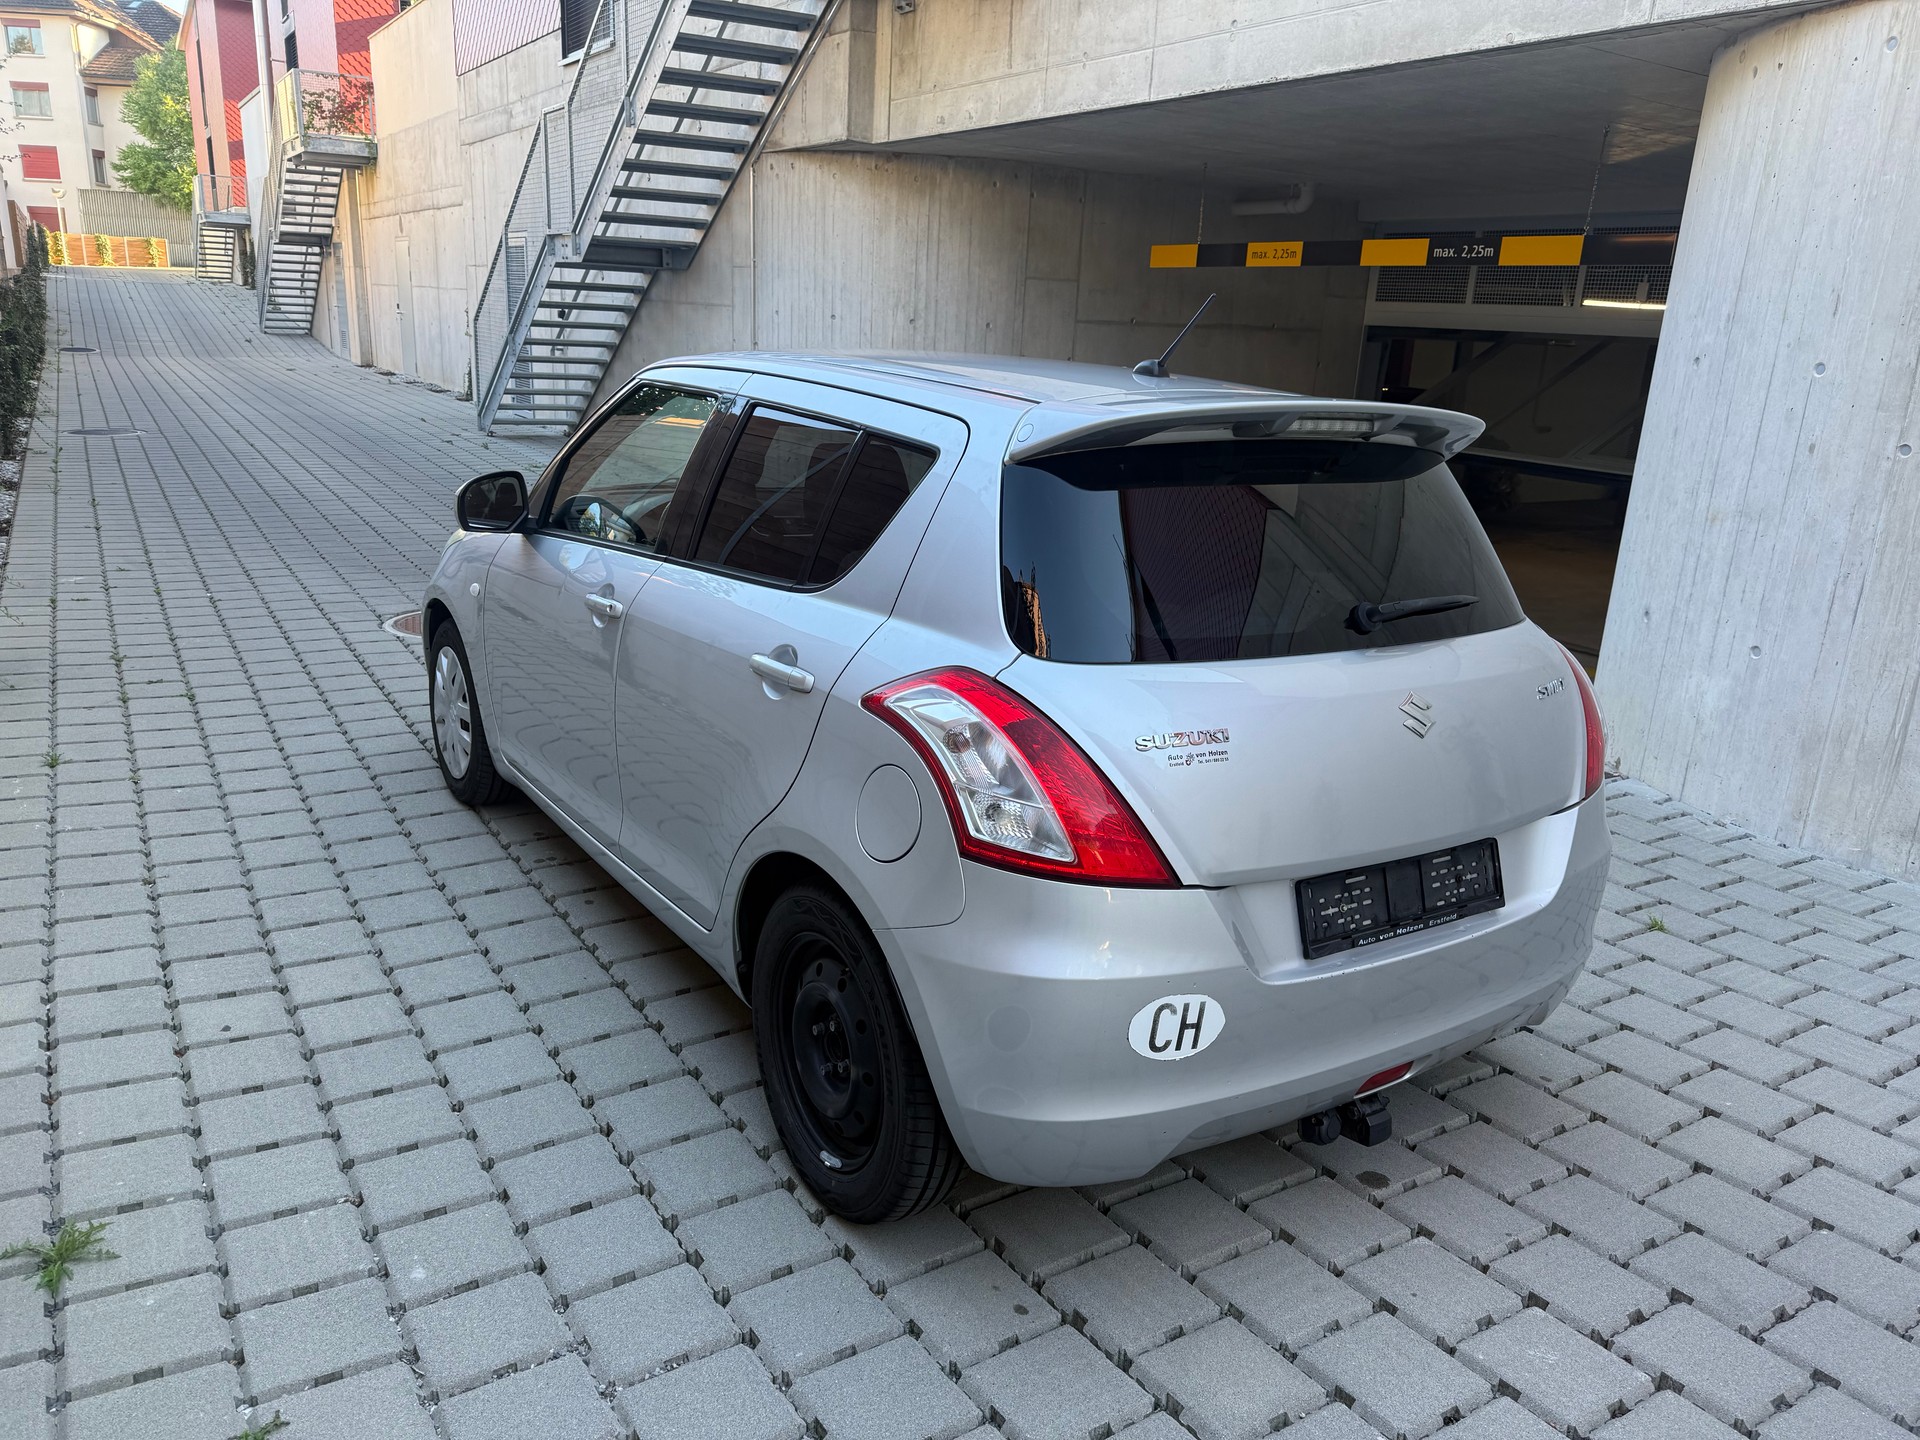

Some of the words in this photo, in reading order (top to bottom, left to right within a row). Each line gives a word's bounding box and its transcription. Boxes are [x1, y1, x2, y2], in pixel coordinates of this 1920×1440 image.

[1252, 251, 1270, 259] max.
[1273, 248, 1297, 260] 2,25m
[1433, 247, 1458, 258] max.
[1461, 244, 1494, 259] 2,25m
[1135, 728, 1230, 752] SUZUKI
[1167, 753, 1184, 762] Auto
[1358, 937, 1376, 946] Auto
[1380, 932, 1394, 940] von
[1396, 923, 1424, 936] Holzen
[1429, 913, 1457, 927] Erstfeld
[1148, 1001, 1207, 1054] CH
